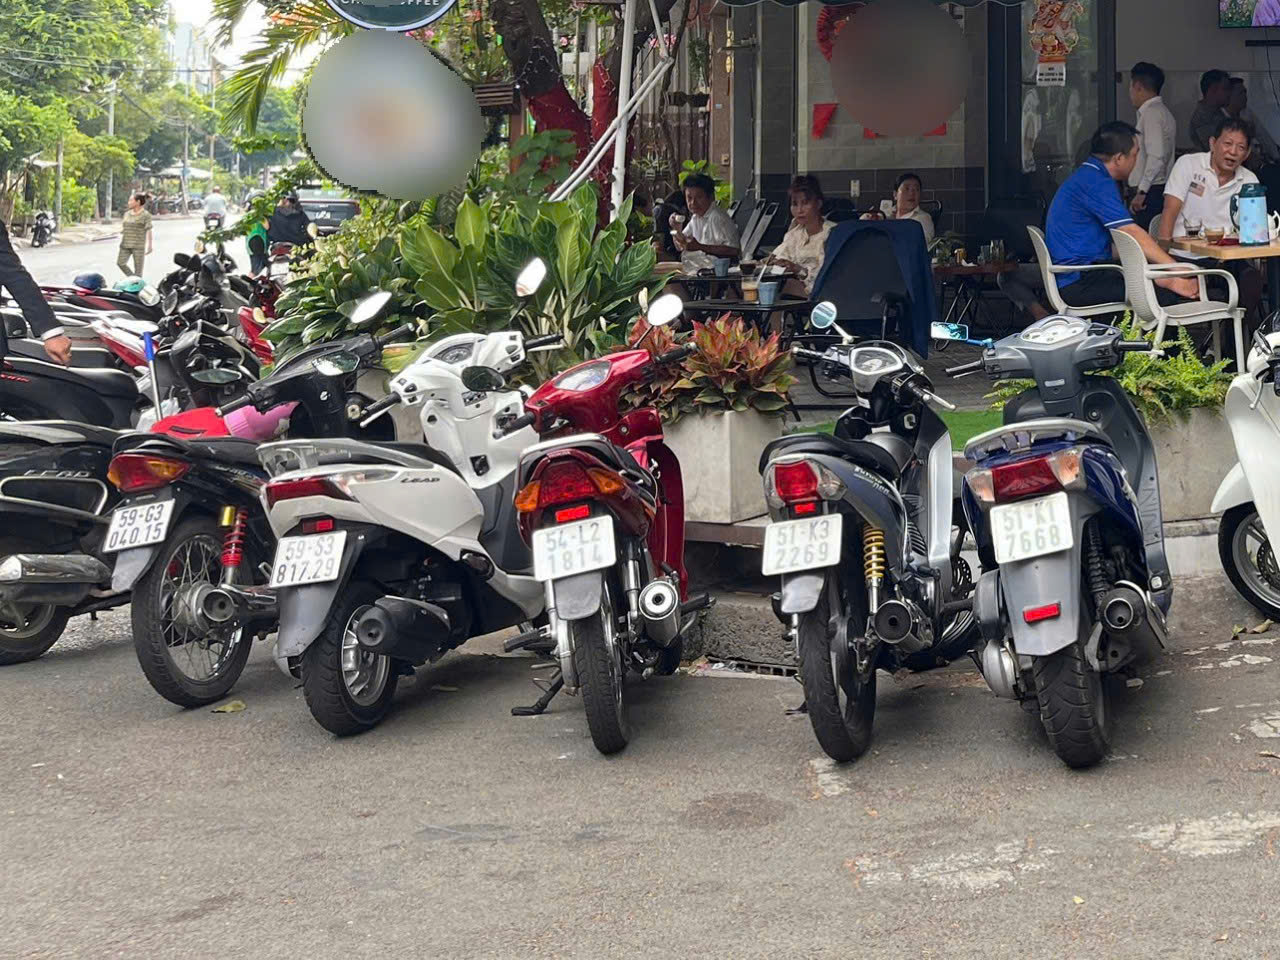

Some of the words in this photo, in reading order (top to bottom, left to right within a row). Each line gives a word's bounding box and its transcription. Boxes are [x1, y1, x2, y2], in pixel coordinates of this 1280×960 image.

[119, 503, 164, 528] 59-G3
[109, 522, 165, 549] 040.15
[776, 520, 830, 546] 51-K3
[1006, 524, 1060, 557] 7668
[285, 535, 335, 561] 59-S3
[774, 542, 829, 570] 2269
[276, 557, 335, 584] 817.29
